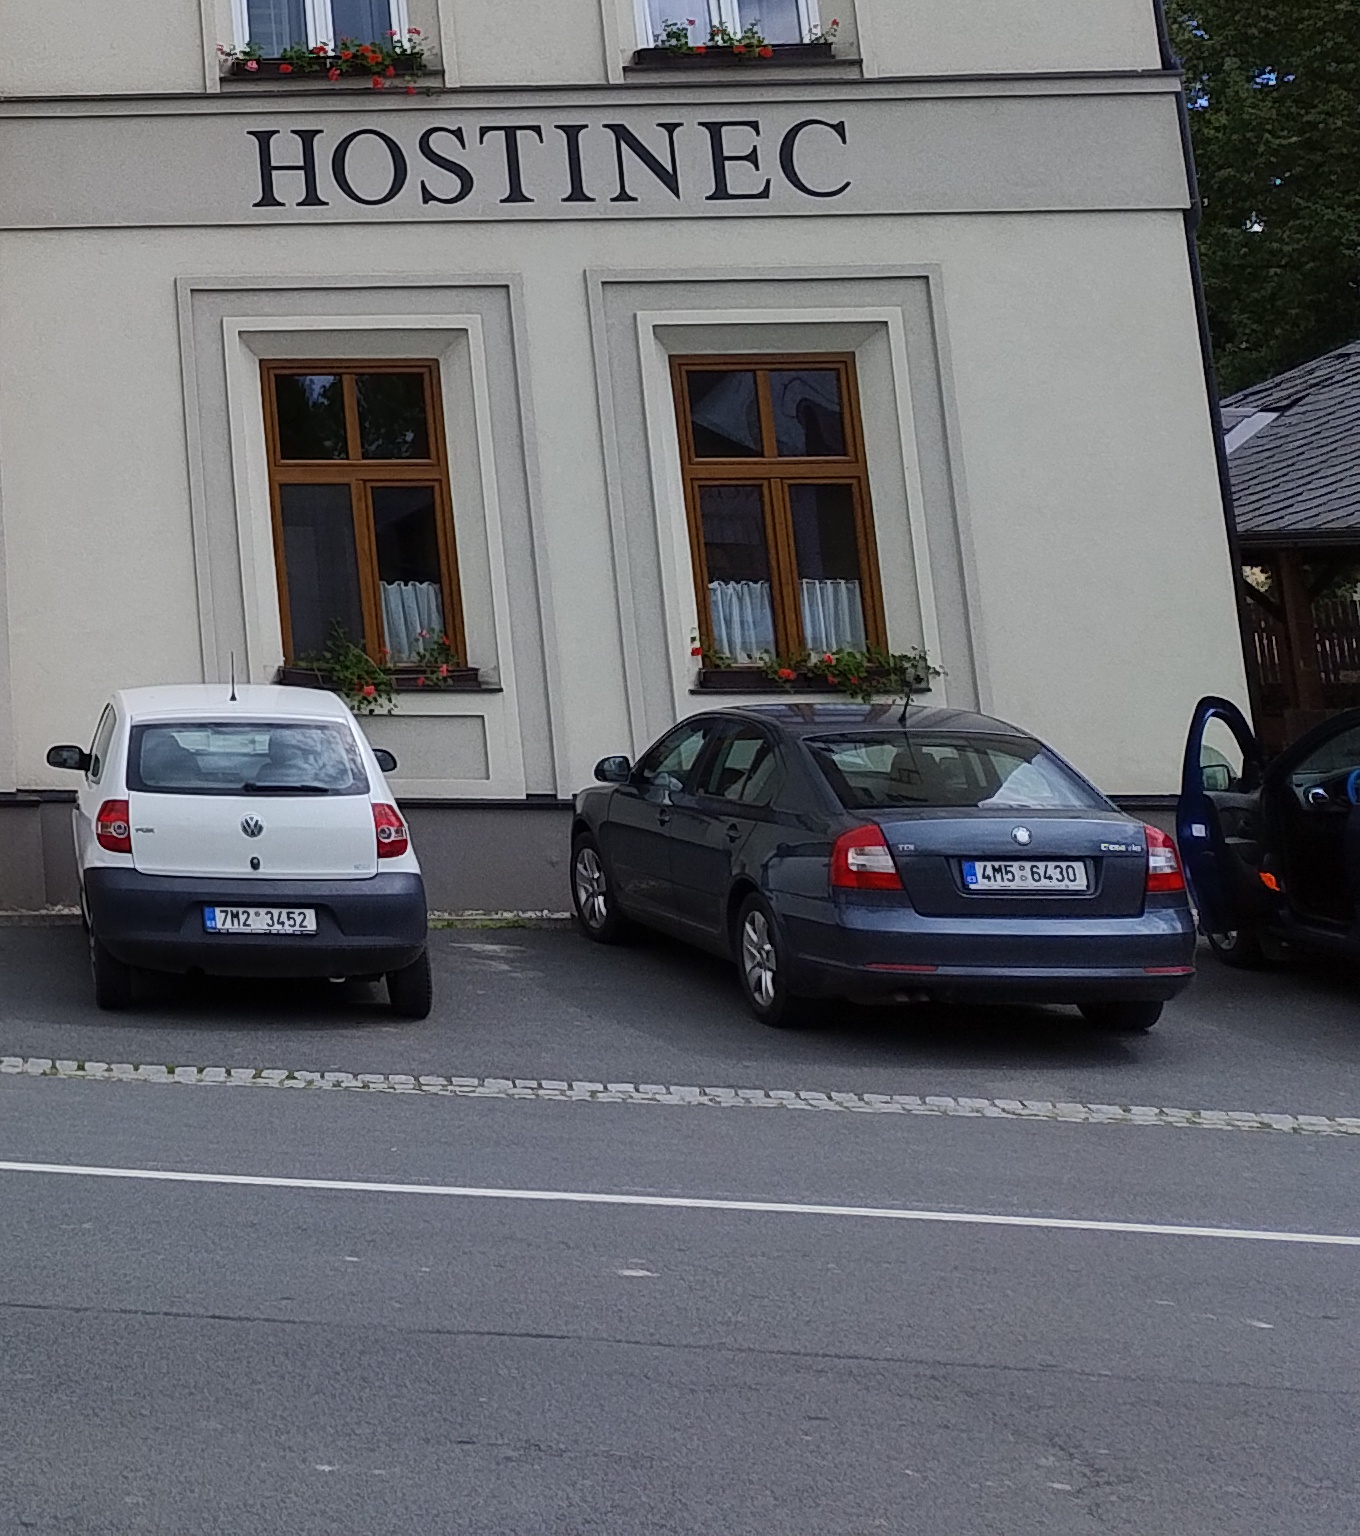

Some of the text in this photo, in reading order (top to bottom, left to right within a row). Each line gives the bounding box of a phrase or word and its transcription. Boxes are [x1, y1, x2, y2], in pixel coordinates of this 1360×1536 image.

[246, 118, 852, 207] HOSTINEC
[981, 864, 1077, 883] 4M5 6430
[219, 909, 308, 929] 7M2 3452
